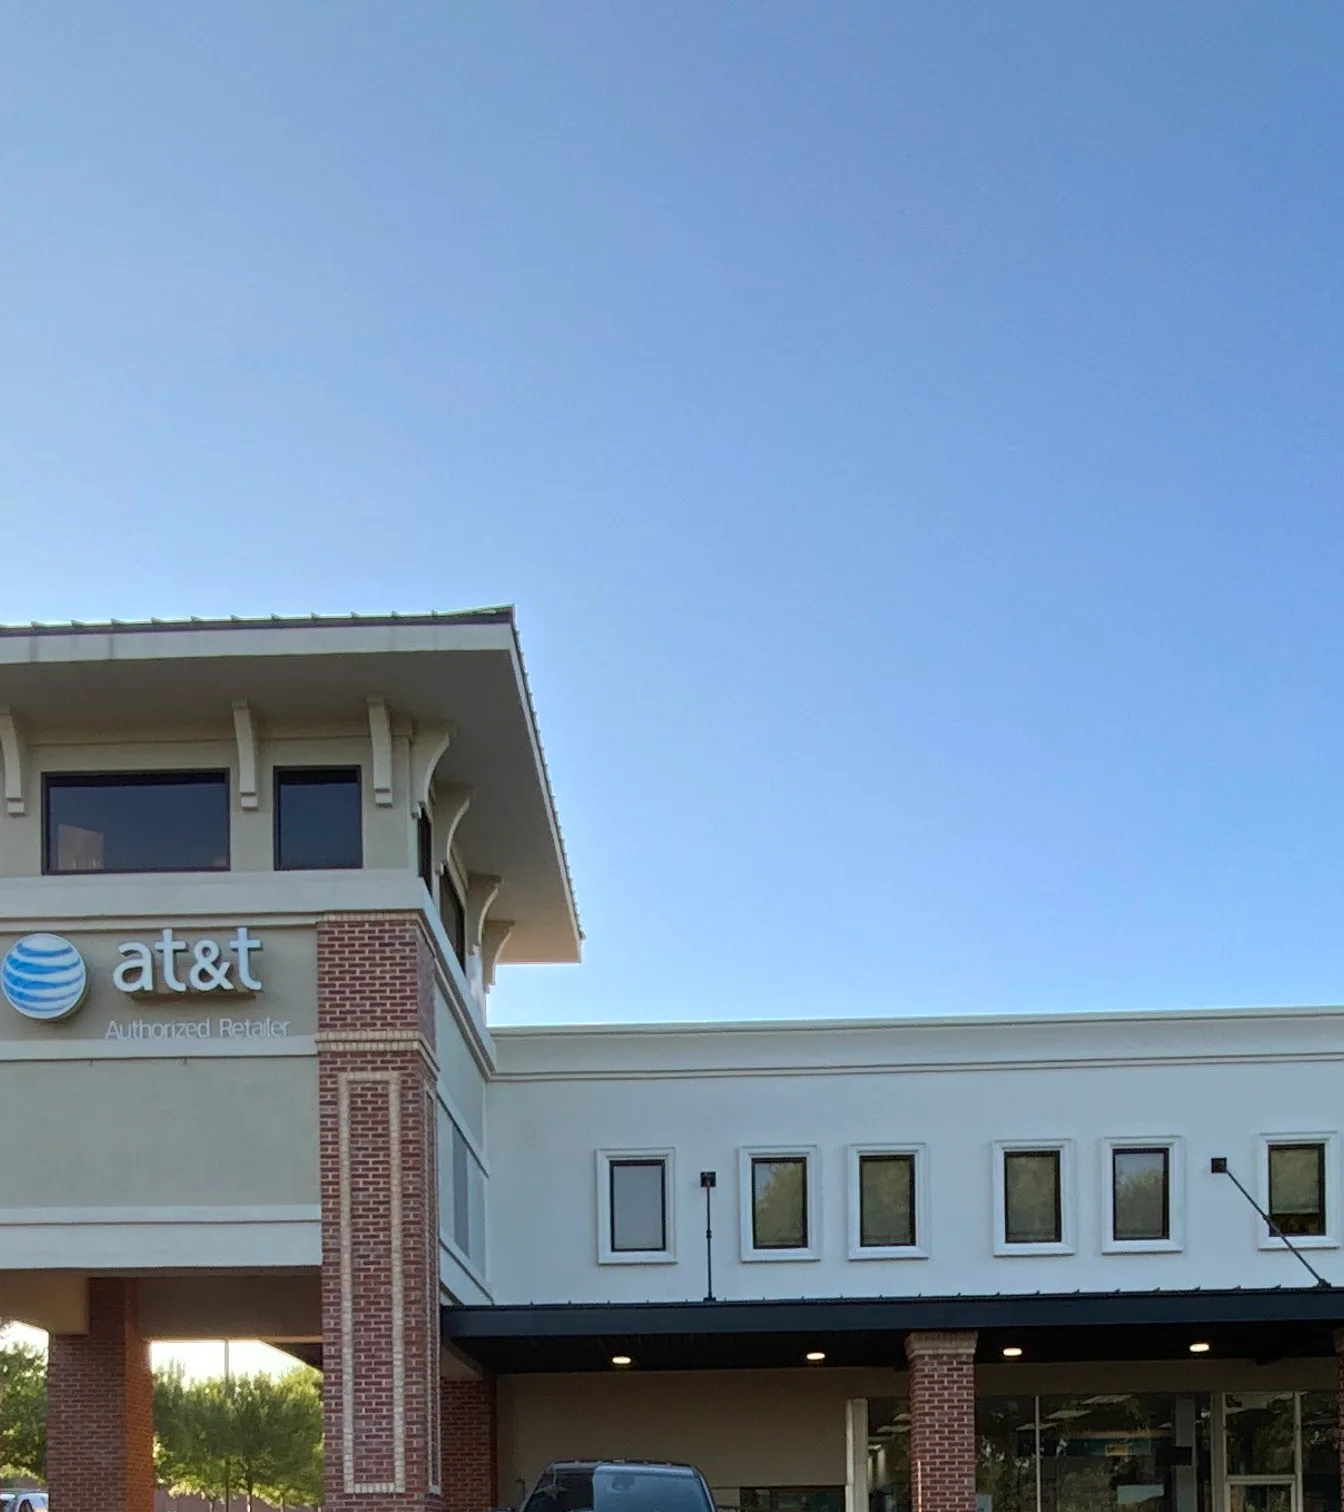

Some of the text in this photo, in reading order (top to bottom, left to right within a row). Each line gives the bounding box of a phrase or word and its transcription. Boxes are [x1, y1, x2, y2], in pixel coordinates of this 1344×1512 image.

[113, 927, 262, 992] at&t
[105, 1017, 291, 1041] Authorized Retailer
